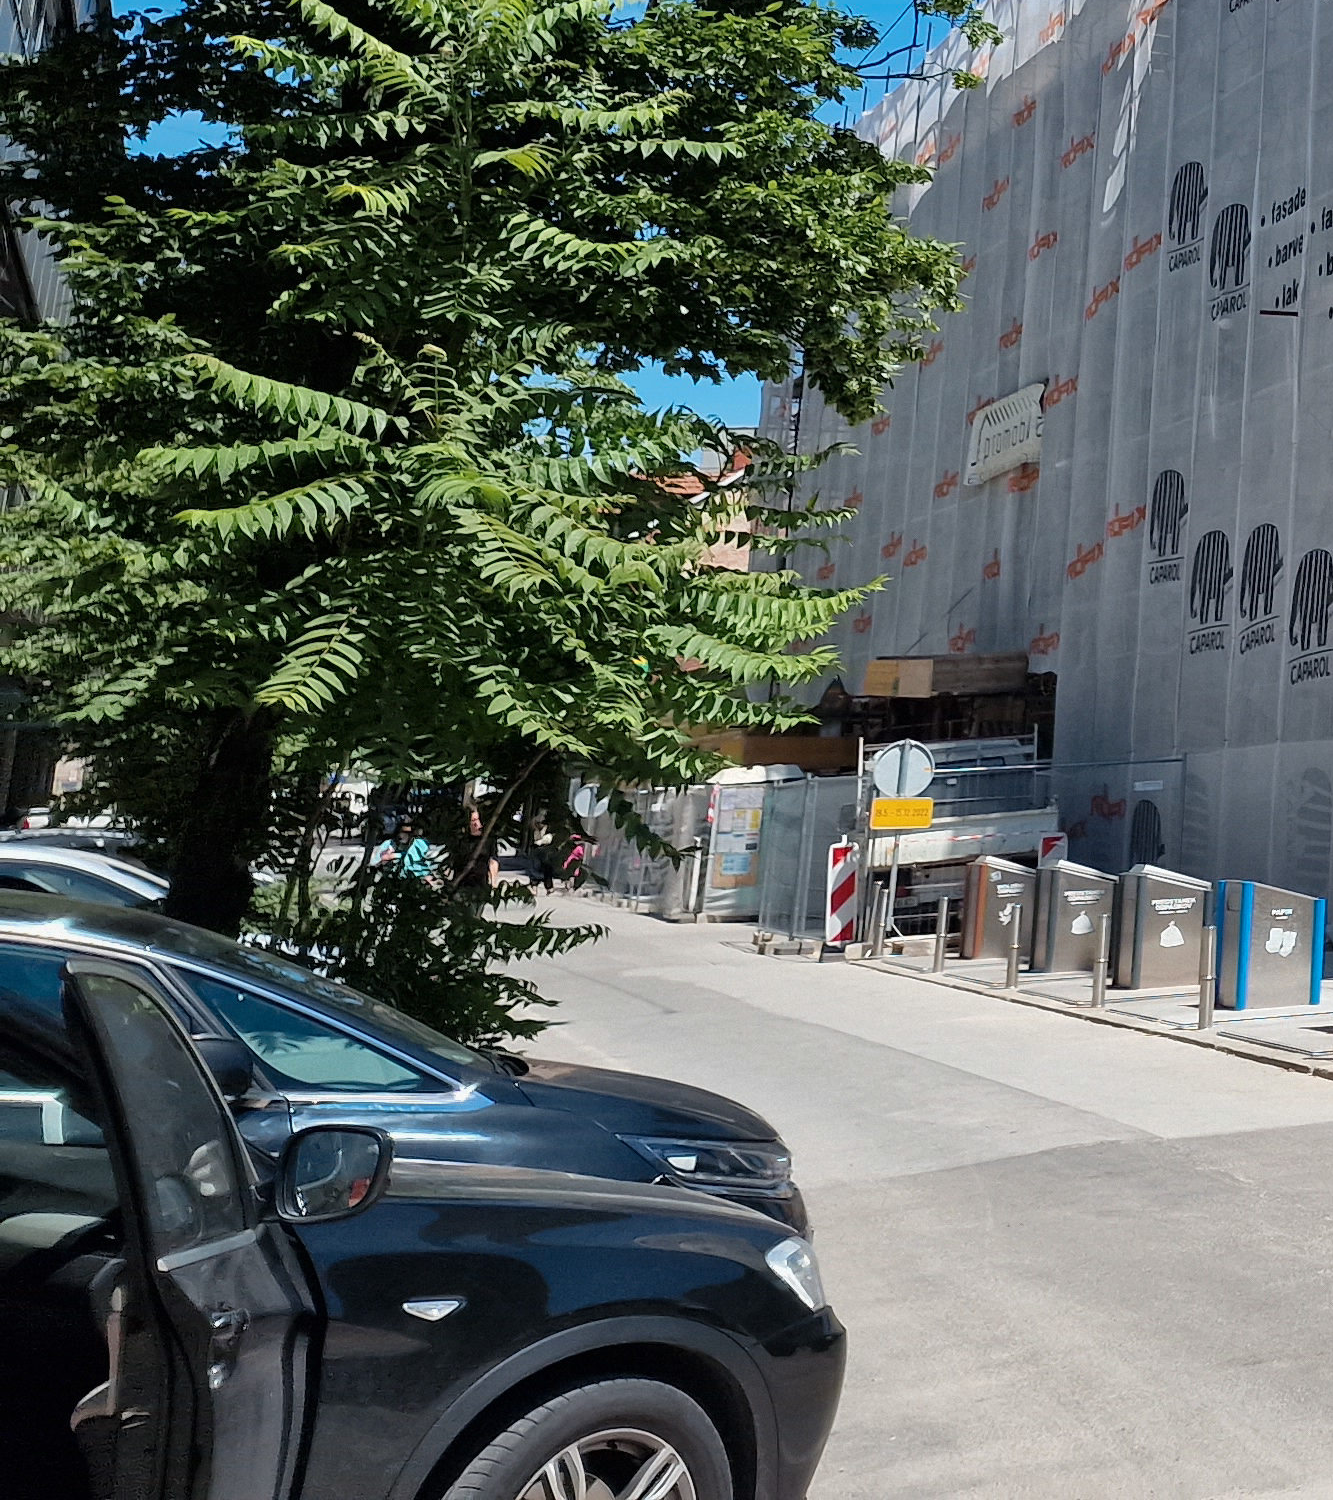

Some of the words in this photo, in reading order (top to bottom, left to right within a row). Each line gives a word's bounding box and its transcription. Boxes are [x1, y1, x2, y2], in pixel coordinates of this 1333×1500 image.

[1271, 186, 1306, 225] fasade
[1168, 246, 1201, 273] CAPAROL
[1274, 234, 1304, 267] barve
[1282, 278, 1299, 309] lak
[1148, 564, 1181, 585] CAPAROL
[1188, 628, 1226, 655] CAPAROL
[1239, 625, 1276, 655] CAPAROL
[1289, 655, 1332, 686] CAPAROL
